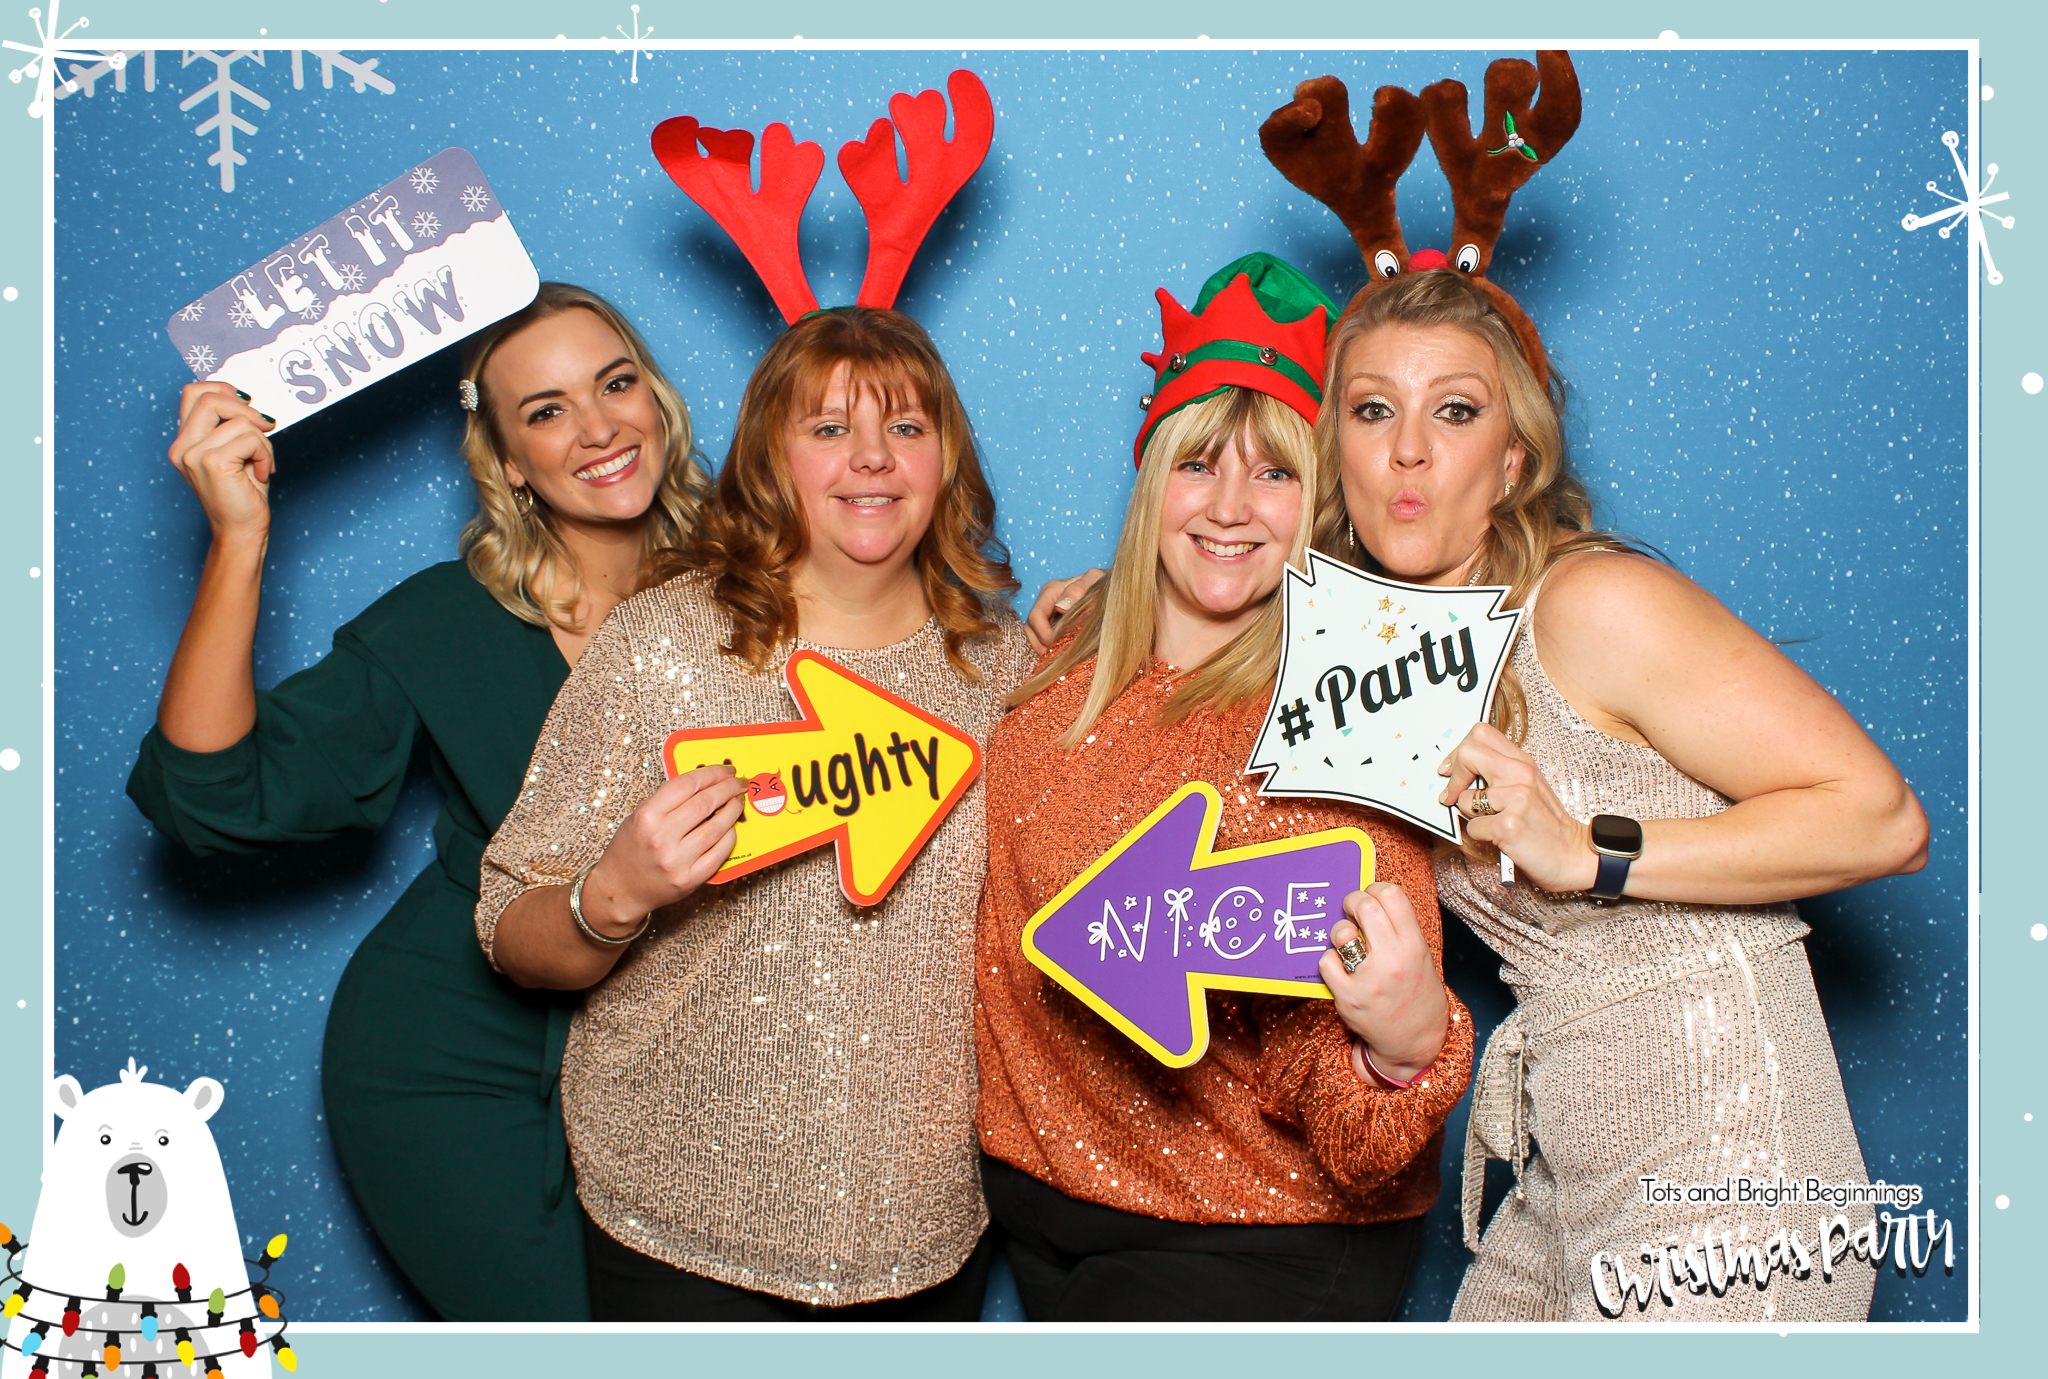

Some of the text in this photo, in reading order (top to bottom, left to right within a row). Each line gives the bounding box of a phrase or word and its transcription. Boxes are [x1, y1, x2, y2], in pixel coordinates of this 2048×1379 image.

[230, 194, 415, 330] LET IT
[278, 264, 466, 405] SNOW
[1276, 625, 1480, 748] #Party
[1088, 881, 1331, 963] NICE
